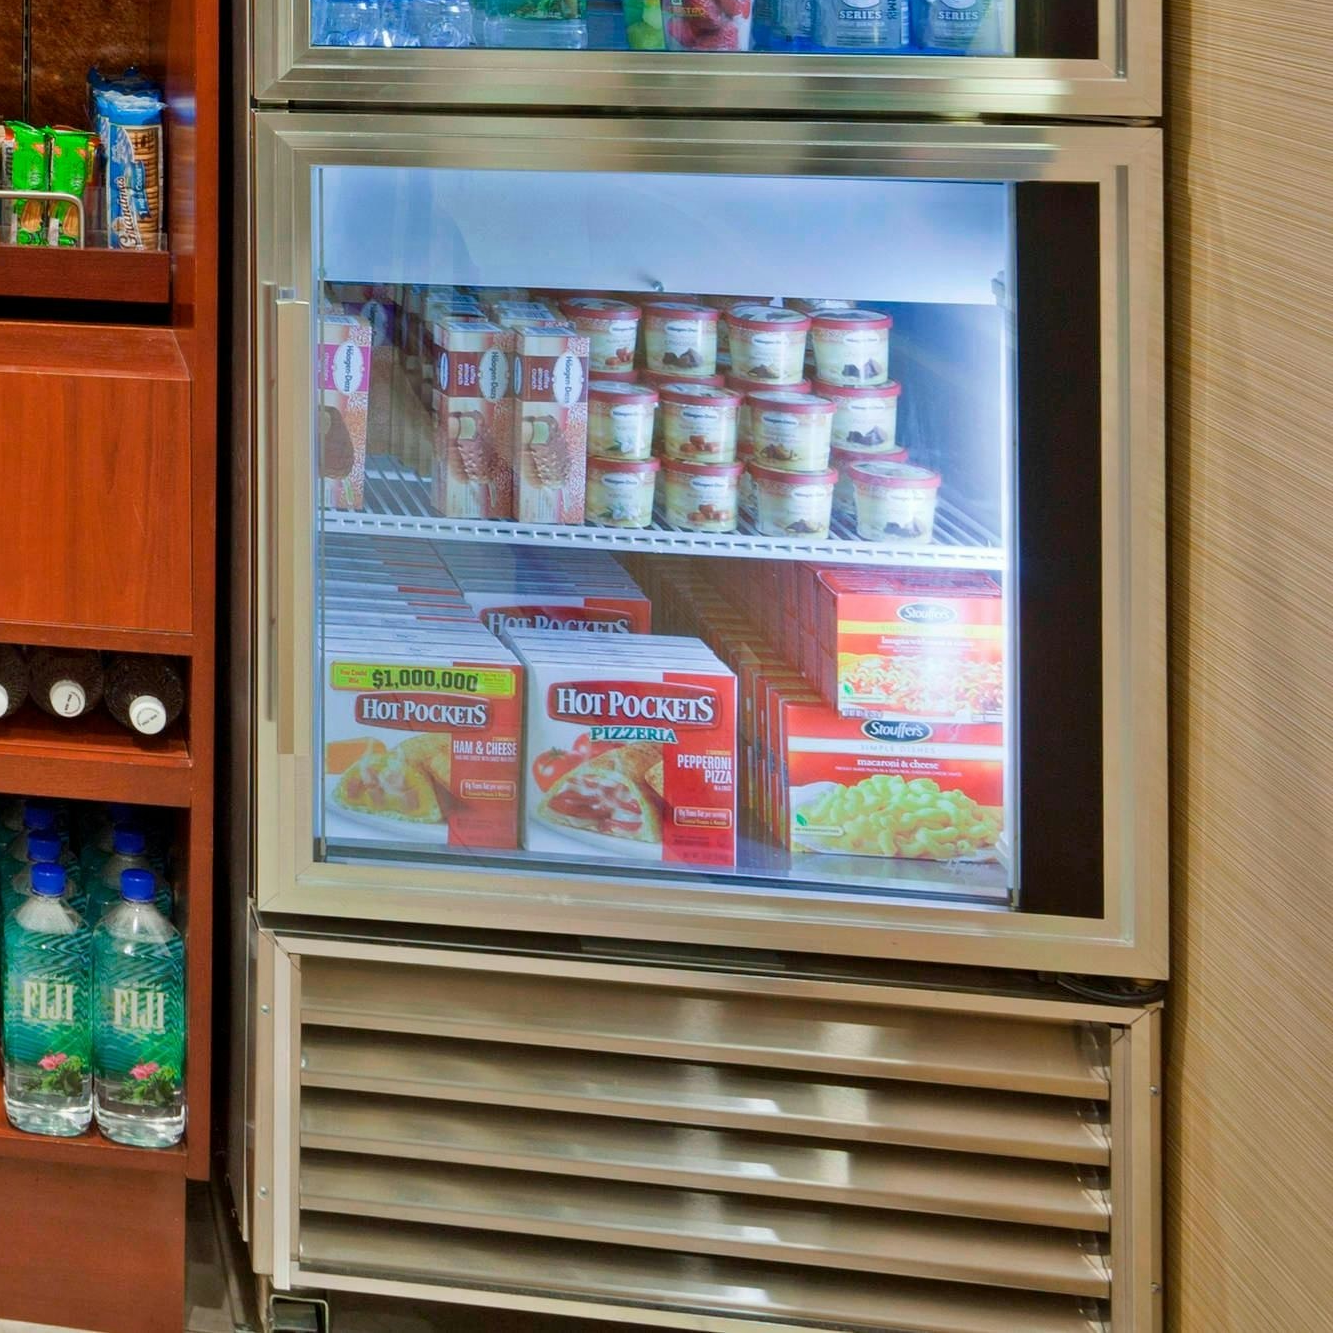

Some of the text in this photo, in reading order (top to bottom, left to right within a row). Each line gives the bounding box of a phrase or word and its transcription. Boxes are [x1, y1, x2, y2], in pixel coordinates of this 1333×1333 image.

[839, 10, 882, 20] SERIES
[938, 11, 979, 20] SERIES
[372, 669, 478, 692] $1,000,000
[363, 698, 487, 726] HOT POCKETS
[557, 688, 714, 722] HOT POCKETS
[589, 726, 678, 743] PIZZERIA
[870, 721, 925, 739] Stouffer's
[453, 741, 517, 756] HAM & CHEESE
[677, 754, 732, 771] PEPPERONI
[857, 758, 939, 770] macaroni & cheese
[704, 770, 732, 784] PIZZA
[23, 978, 76, 1022] FIJI
[113, 986, 167, 1030] FIJI
